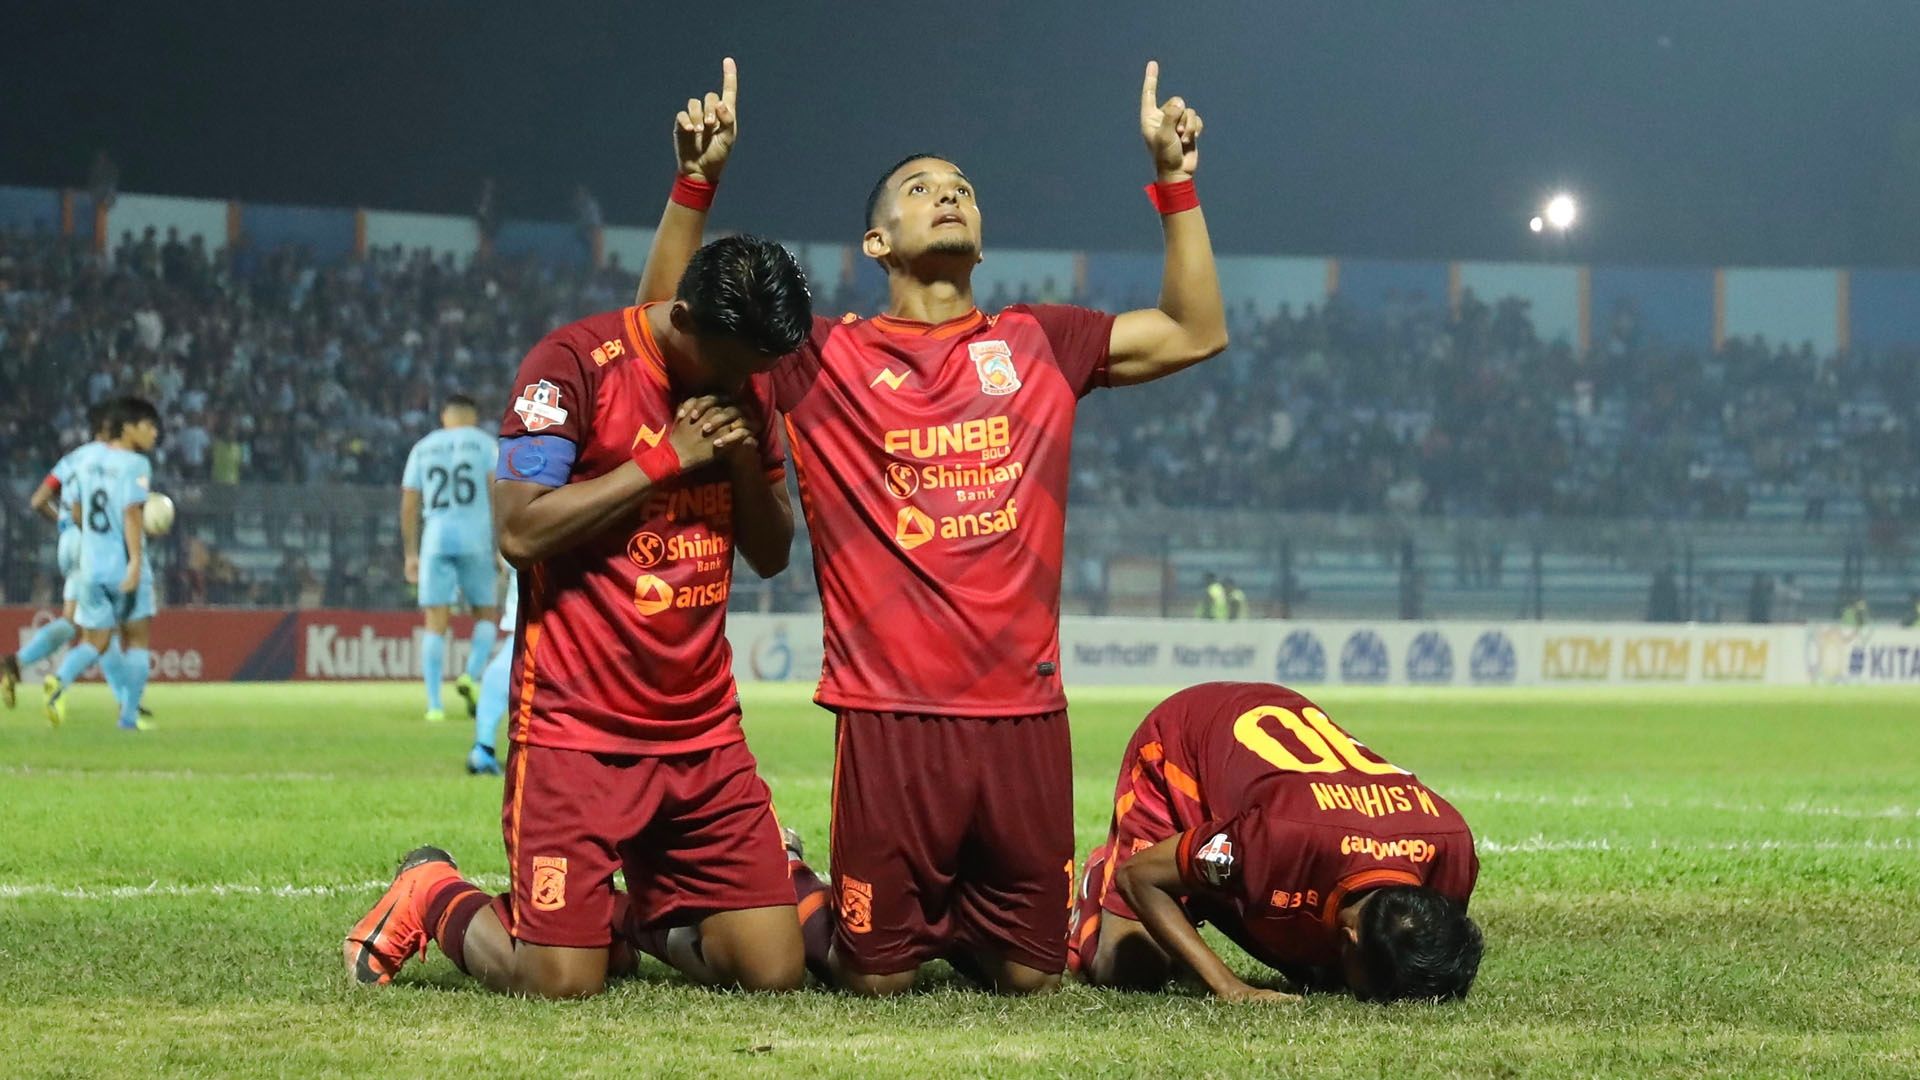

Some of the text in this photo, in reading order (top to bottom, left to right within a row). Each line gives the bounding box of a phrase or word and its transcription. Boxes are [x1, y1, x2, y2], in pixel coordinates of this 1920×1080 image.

[884, 415, 1010, 459] FUN88
[981, 446, 1012, 461] BOLA
[427, 462, 477, 510] 26
[921, 461, 1024, 490] Shinhan
[956, 487, 996, 502] Bank
[89, 488, 111, 534] 8
[940, 498, 1018, 540] ansaf
[667, 531, 729, 561] Shinh
[1543, 637, 1769, 679] KTM KTM KTM
